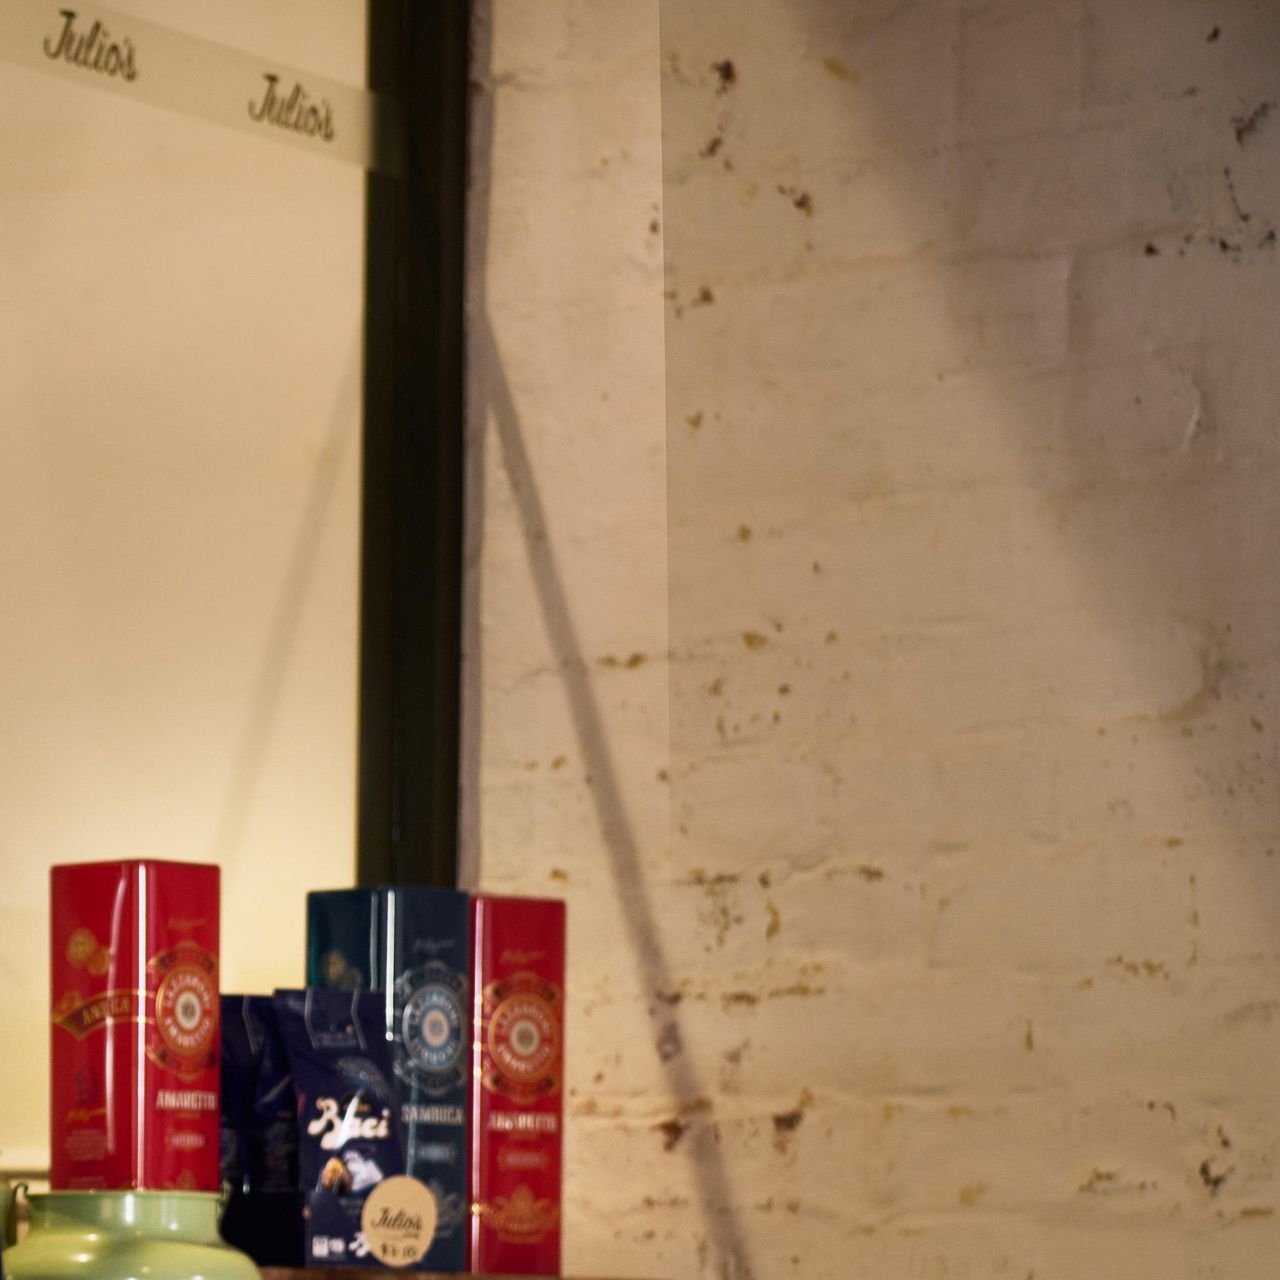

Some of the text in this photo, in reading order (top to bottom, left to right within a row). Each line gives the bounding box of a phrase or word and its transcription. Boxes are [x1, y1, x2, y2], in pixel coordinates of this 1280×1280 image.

[43, 9, 137, 82] Julio's
[248, 73, 335, 142] Julio's
[307, 1097, 390, 1150] Baci
[400, 1103, 465, 1126] SAMBUCA
[370, 1206, 424, 1231] Julio's
